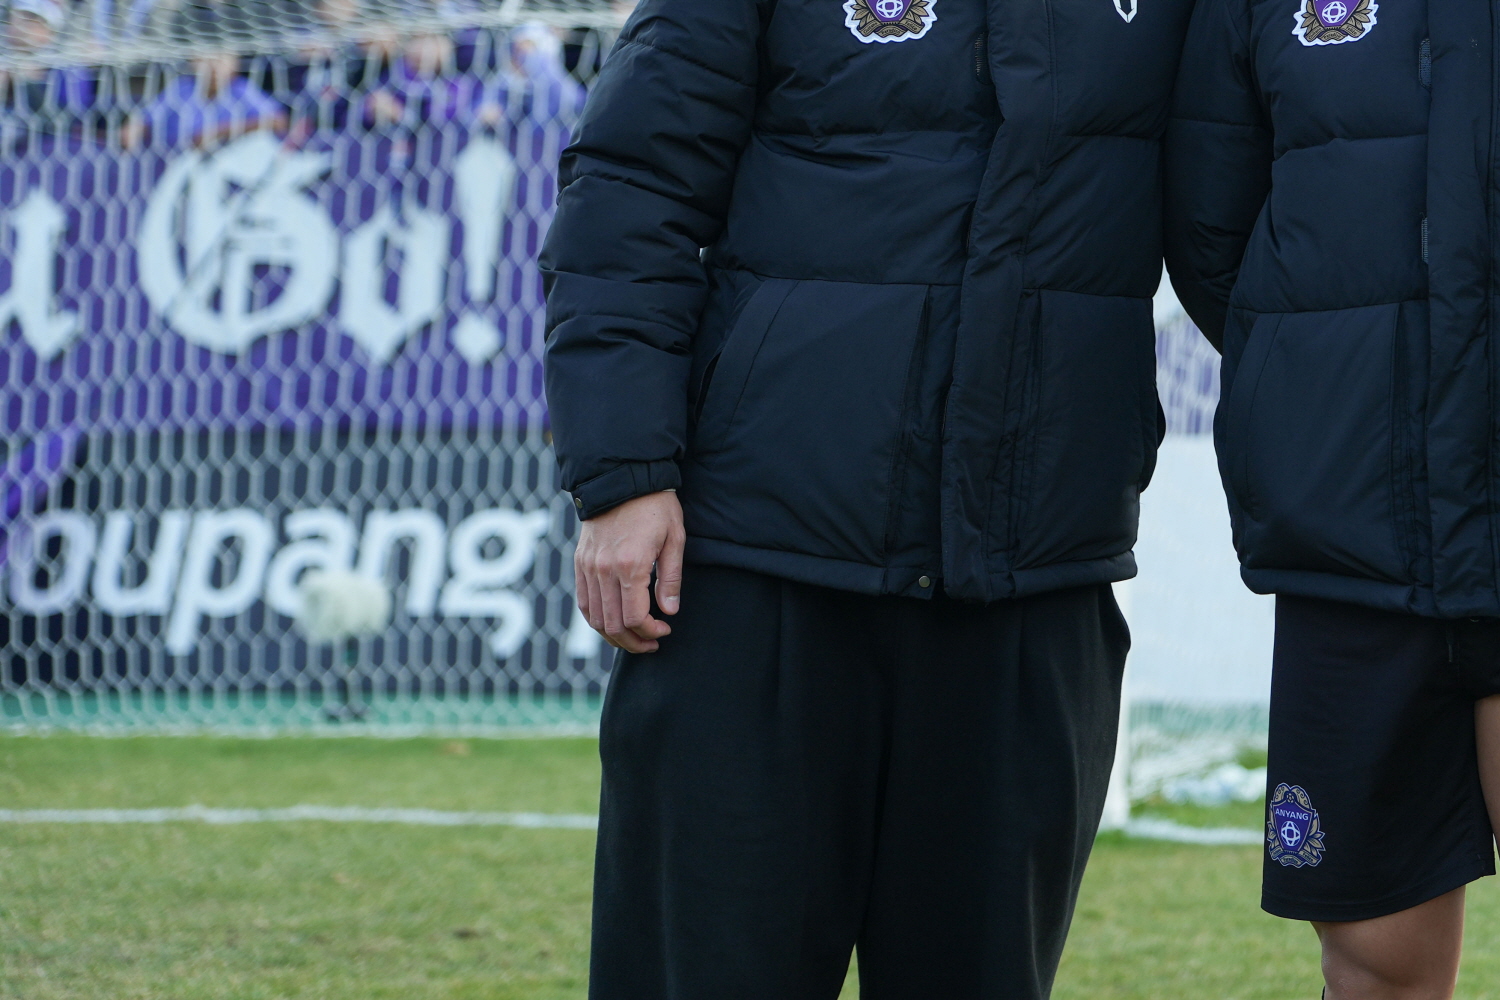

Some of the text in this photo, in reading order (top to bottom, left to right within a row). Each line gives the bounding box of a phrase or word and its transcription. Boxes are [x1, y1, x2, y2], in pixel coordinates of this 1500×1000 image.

[138, 128, 515, 366] Go!
[11, 508, 550, 658] oupang
[1275, 808, 1309, 821] ANYANG
